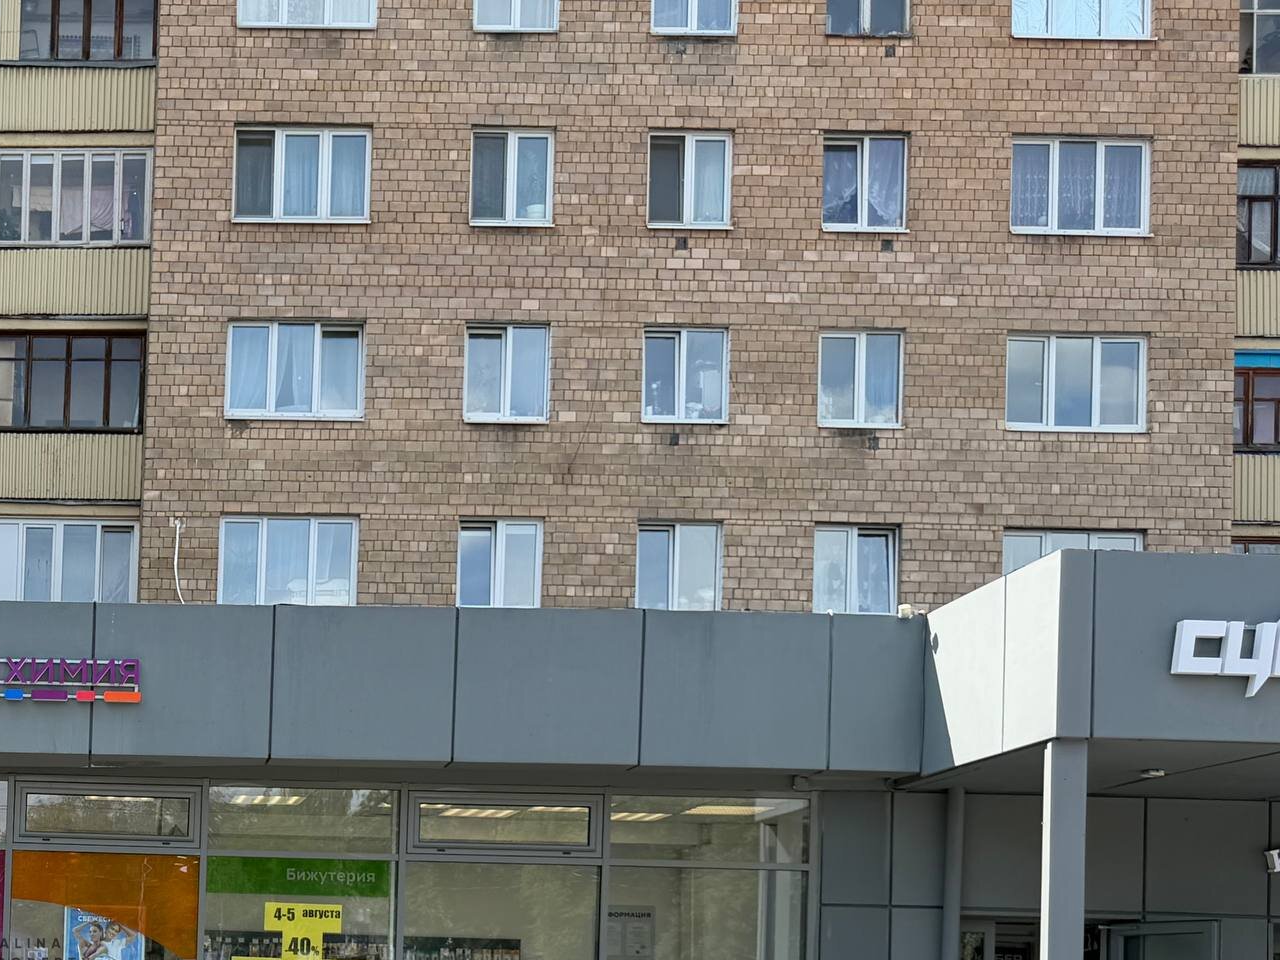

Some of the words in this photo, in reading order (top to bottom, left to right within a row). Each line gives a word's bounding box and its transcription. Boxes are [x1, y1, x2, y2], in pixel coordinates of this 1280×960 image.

[5, 657, 141, 686] ХИМИЯ
[286, 867, 376, 885] Бижутерия
[273, 907, 296, 922] 4-5
[302, 908, 341, 919] августа
[607, 911, 652, 919] ФОРМАЦИЯ
